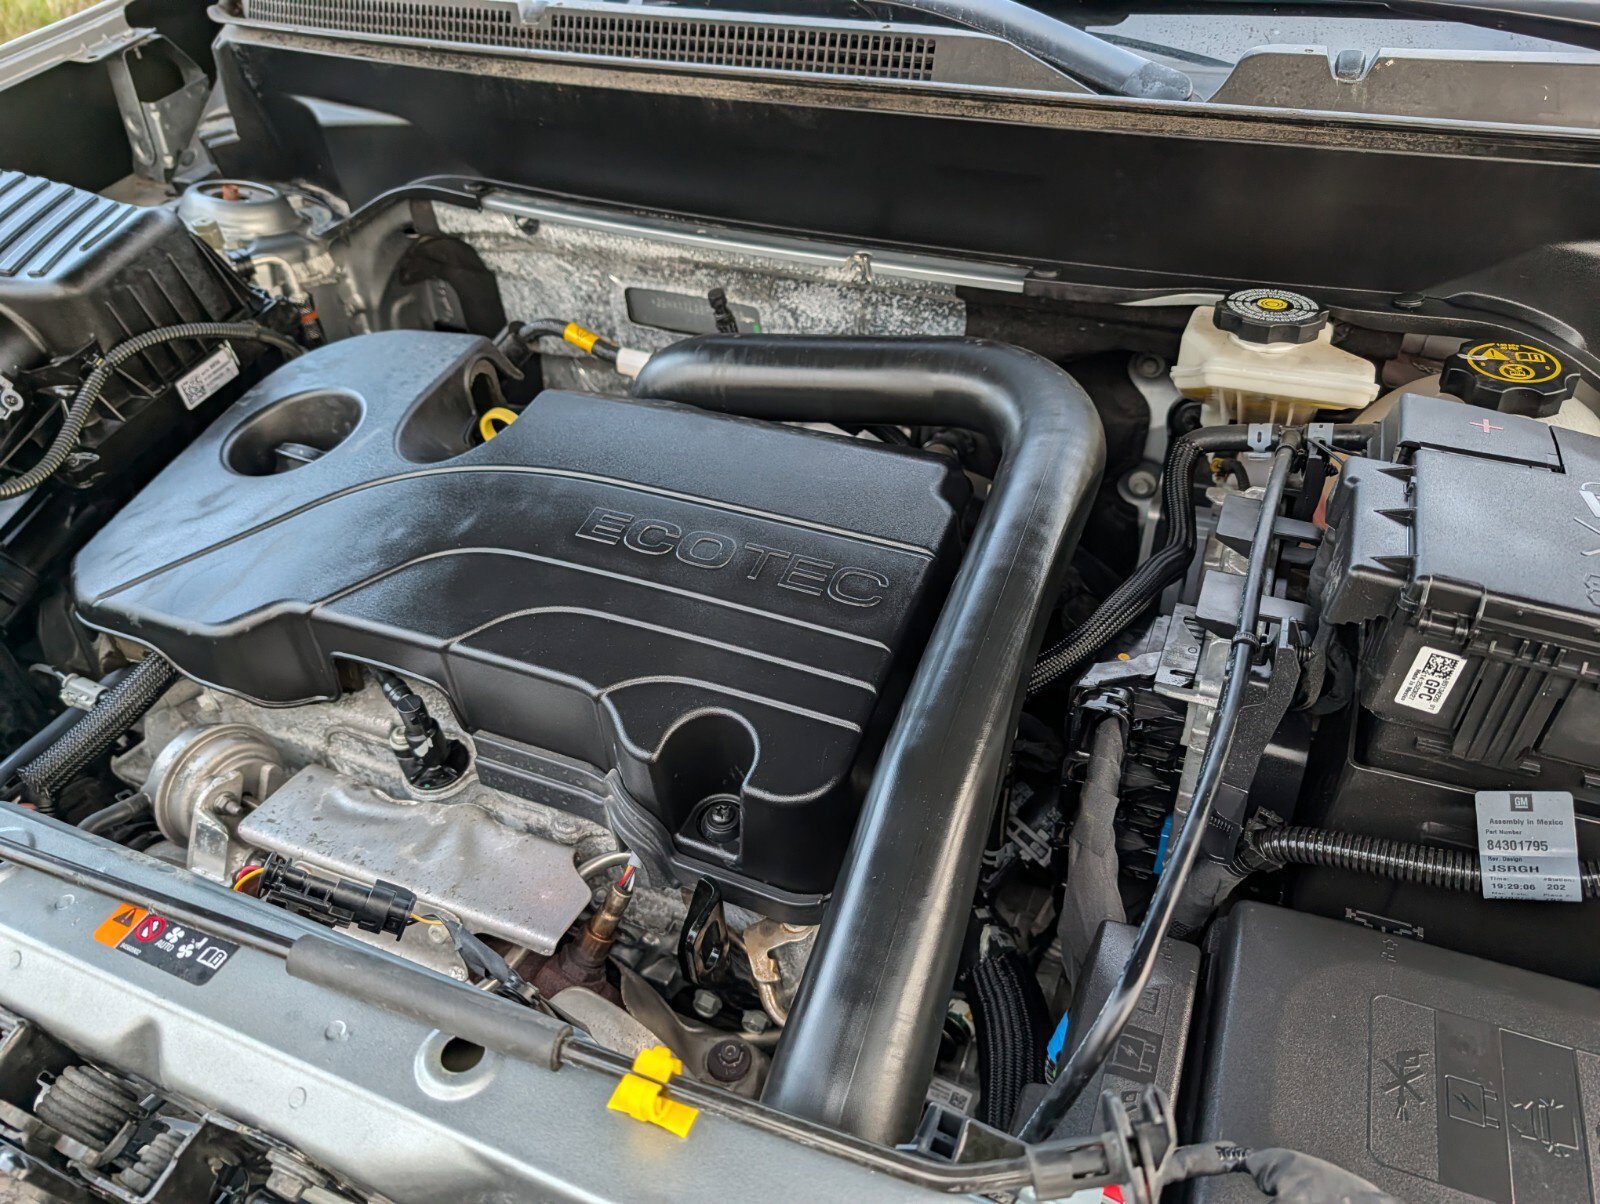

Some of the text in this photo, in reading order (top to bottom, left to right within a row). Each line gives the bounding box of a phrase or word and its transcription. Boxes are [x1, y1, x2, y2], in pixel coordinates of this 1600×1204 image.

[575, 506, 889, 608] ECOTEC
[1418, 679, 1440, 702] GPC
[1514, 796, 1528, 806] GM
[1486, 839, 1548, 851] 84301795
[1488, 865, 1539, 873] JSRGH
[154, 939, 175, 952] AUTO
